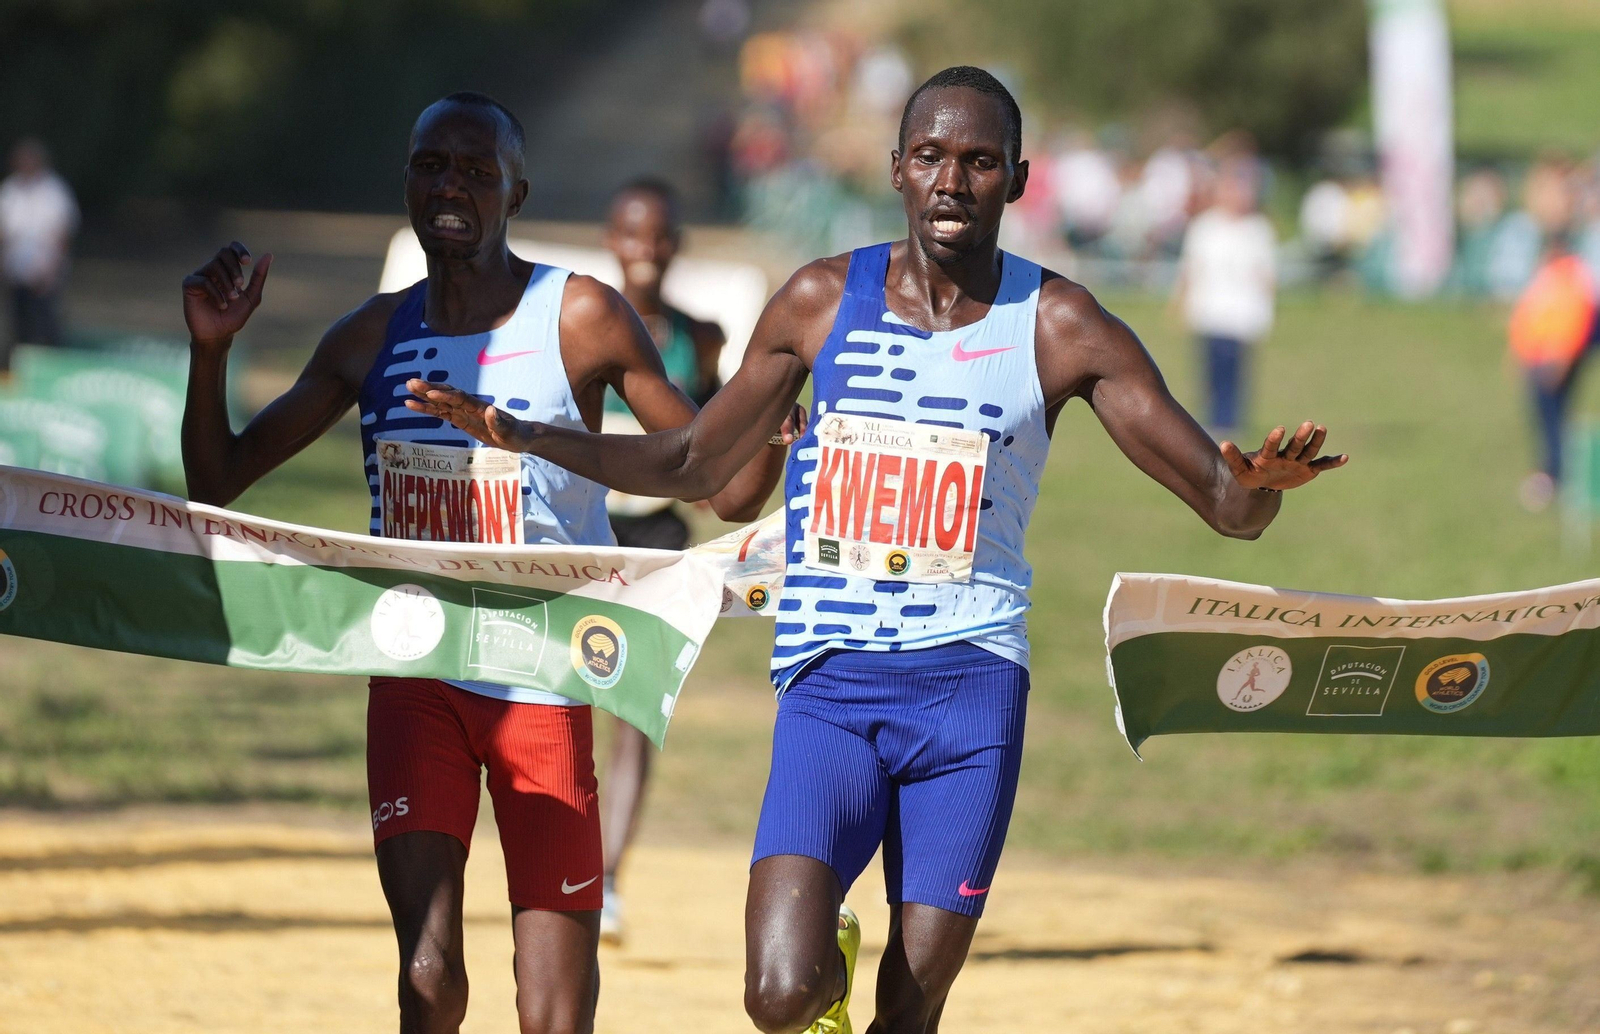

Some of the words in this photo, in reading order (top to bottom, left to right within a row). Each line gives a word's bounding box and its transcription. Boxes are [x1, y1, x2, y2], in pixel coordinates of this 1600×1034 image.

[863, 421, 880, 432] XLI
[411, 447, 424, 456] XLI
[382, 469, 519, 544] CHEPKWONY
[810, 446, 984, 553] KWEMOI
[38, 491, 136, 521] CROSS
[437, 559, 483, 572] DE
[494, 559, 629, 586] ITÁLICA
[1186, 597, 1322, 629] ITALICA
[475, 632, 533, 652] SEVILLA
[587, 659, 612, 674] ATHLETICS
[592, 655, 609, 666] WORLD
[1330, 661, 1387, 676] DIPUTACION
[1424, 663, 1438, 675] GOLD
[1323, 686, 1381, 696] SEVILLA
[372, 796, 409, 831] EOS
